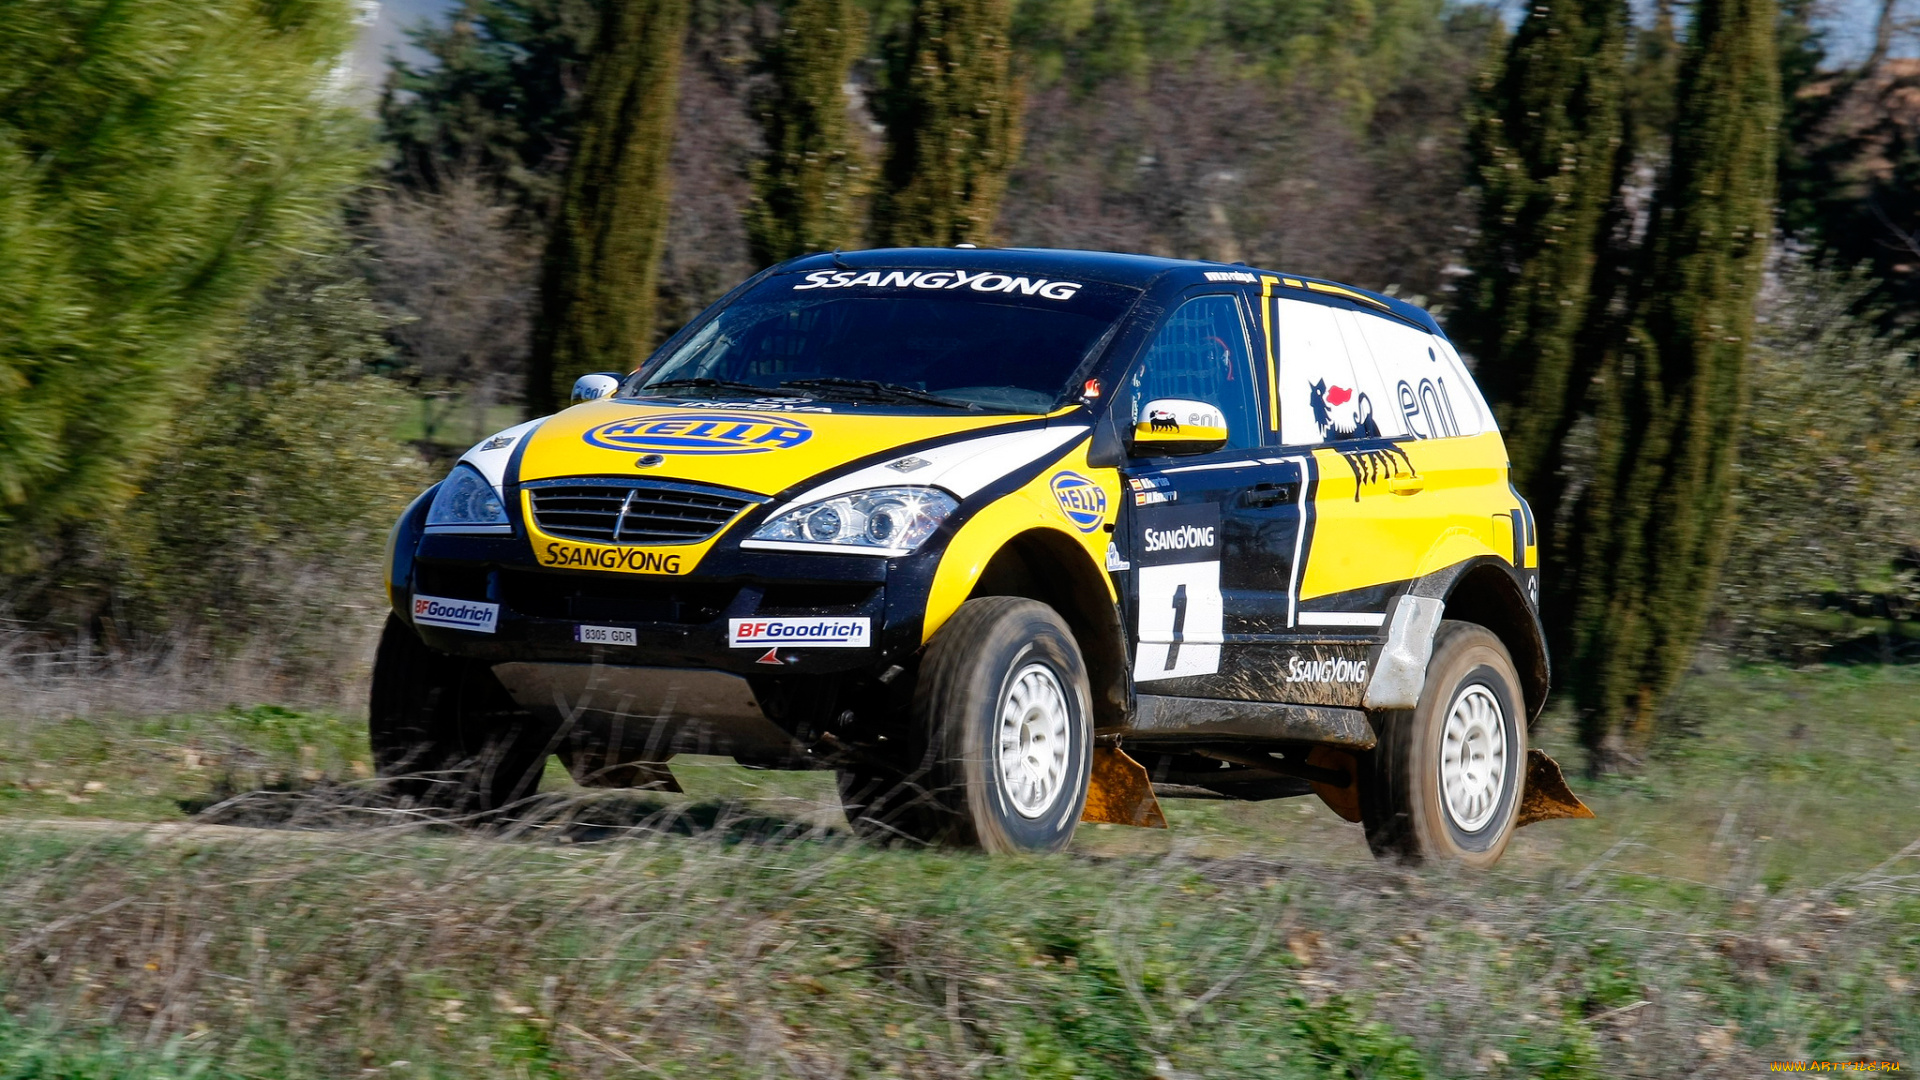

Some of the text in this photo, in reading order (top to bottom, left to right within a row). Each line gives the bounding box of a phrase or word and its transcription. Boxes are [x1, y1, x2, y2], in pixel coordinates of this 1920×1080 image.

[1397, 346, 1461, 440] eni
[1188, 410, 1219, 427] eni
[602, 422, 813, 449] HELLA
[1057, 487, 1106, 514] HELLA
[415, 599, 493, 622] BFGoodrich
[585, 628, 607, 641] 8305
[611, 630, 634, 642] GDR
[737, 622, 863, 637] BFGoodrich
[1163, 584, 1188, 671] 1
